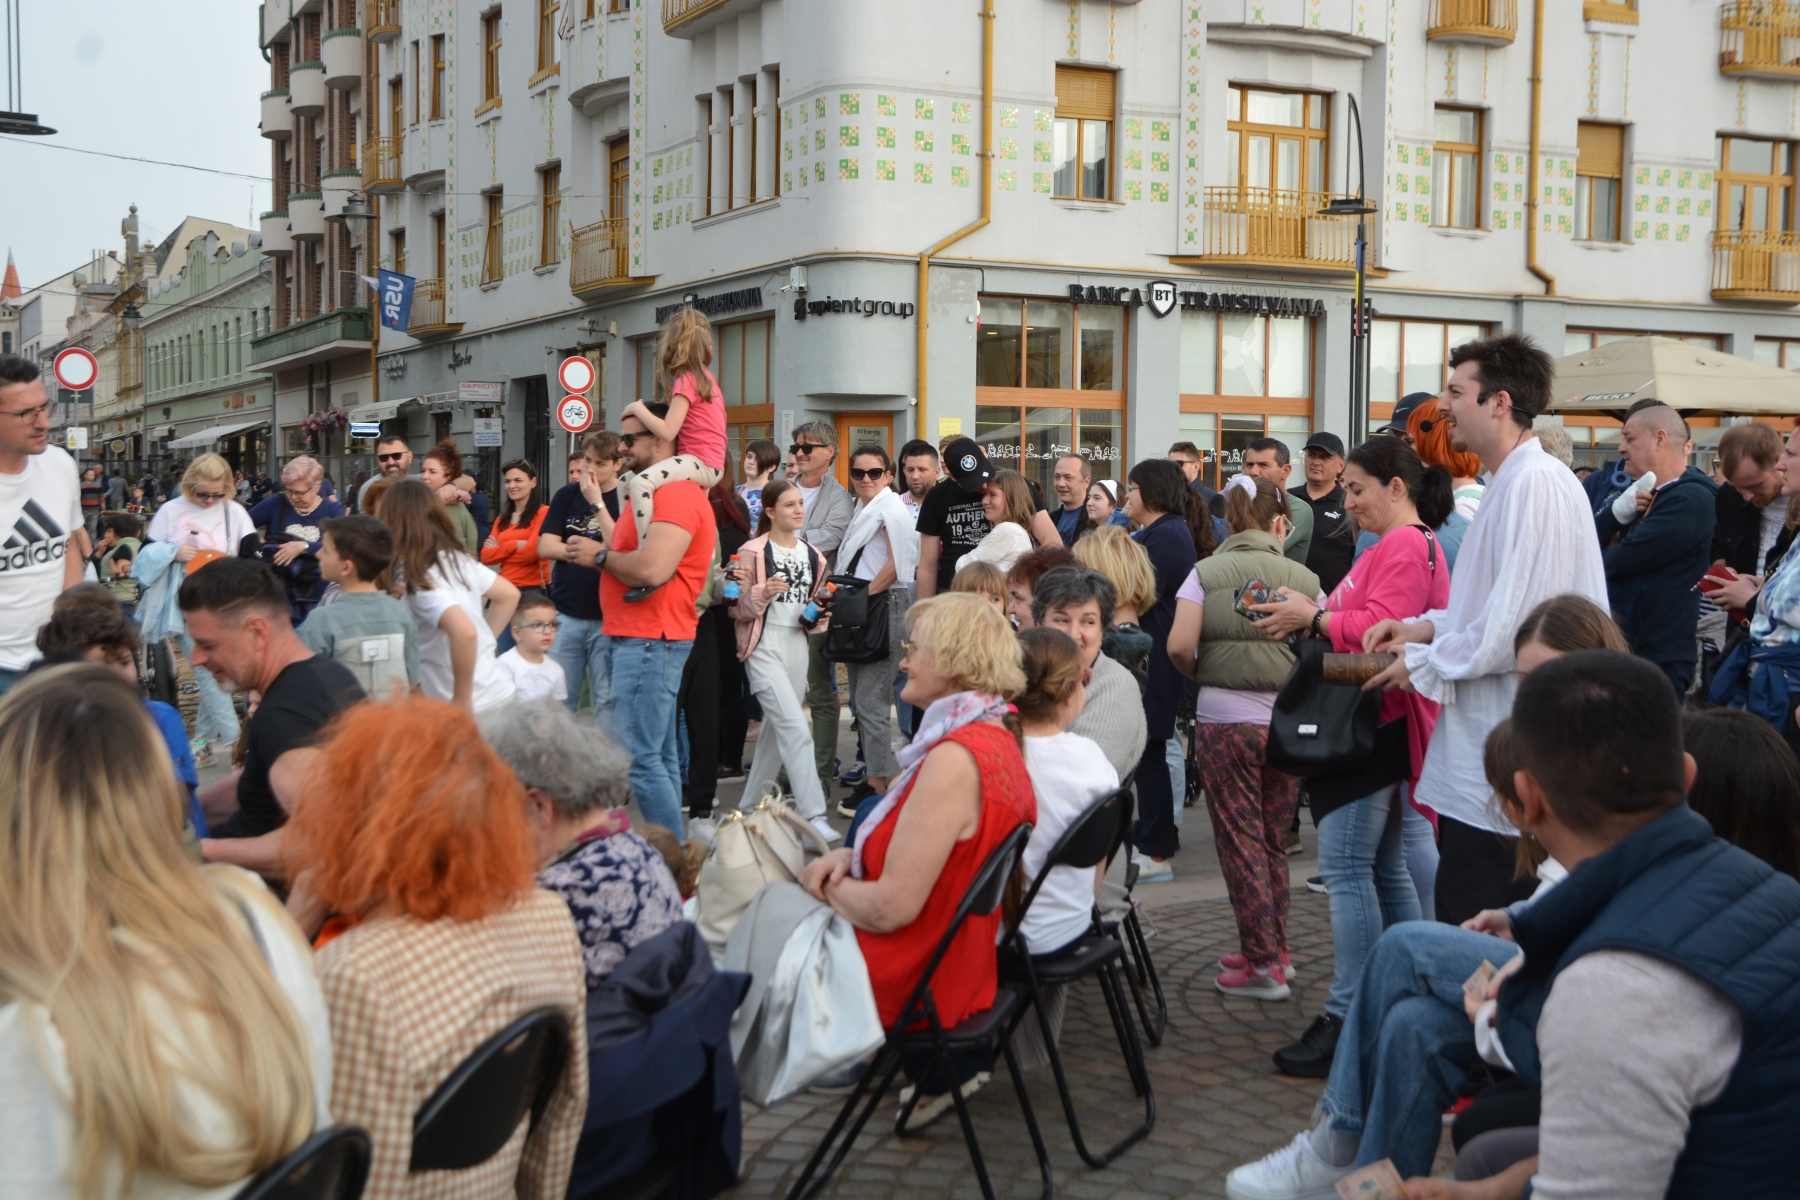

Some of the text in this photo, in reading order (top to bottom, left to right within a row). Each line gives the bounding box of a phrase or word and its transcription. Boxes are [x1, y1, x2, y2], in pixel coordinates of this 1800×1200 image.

[1069, 284, 1327, 317] BANCA BT TRANSILVANIA
